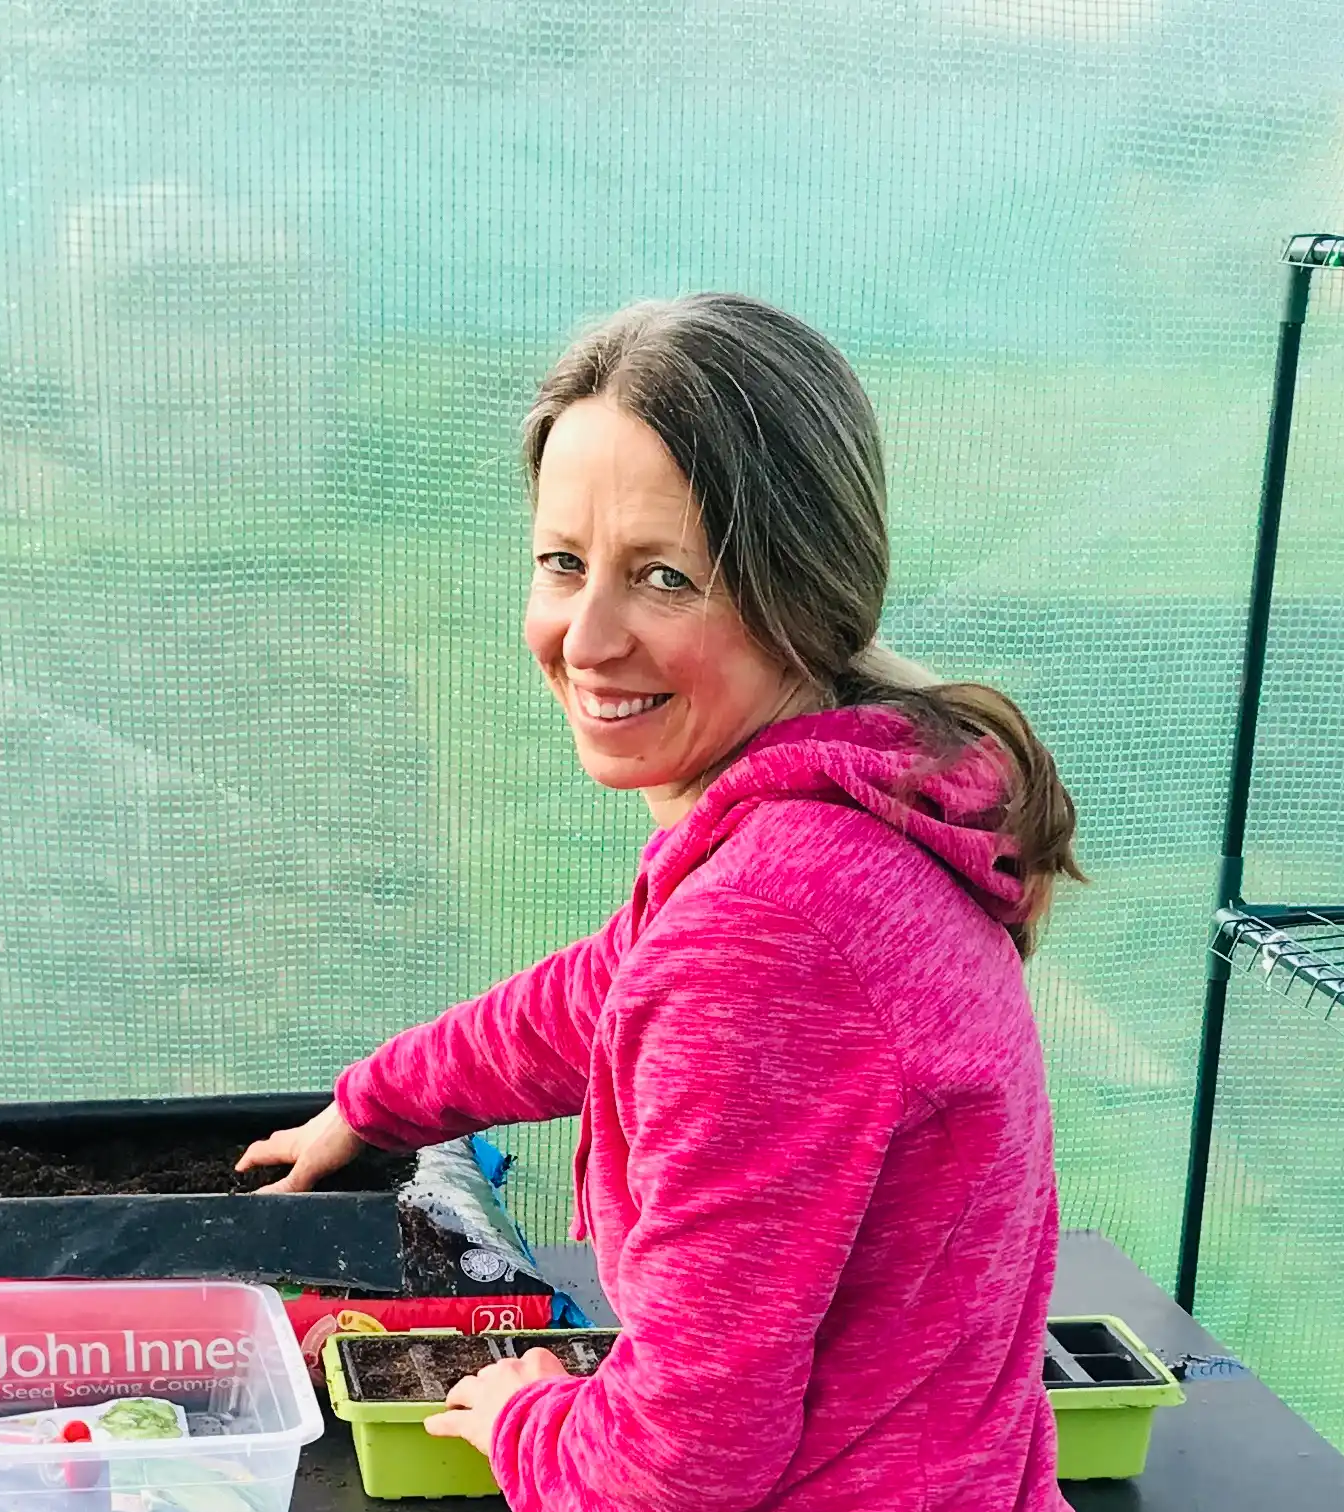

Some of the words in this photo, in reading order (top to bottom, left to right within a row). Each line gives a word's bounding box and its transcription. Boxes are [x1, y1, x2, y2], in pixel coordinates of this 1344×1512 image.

[479, 1309, 516, 1334] 28
[122, 1330, 253, 1374] Innes
[2, 1382, 55, 1400] Seed
[63, 1379, 143, 1397] Sowing
